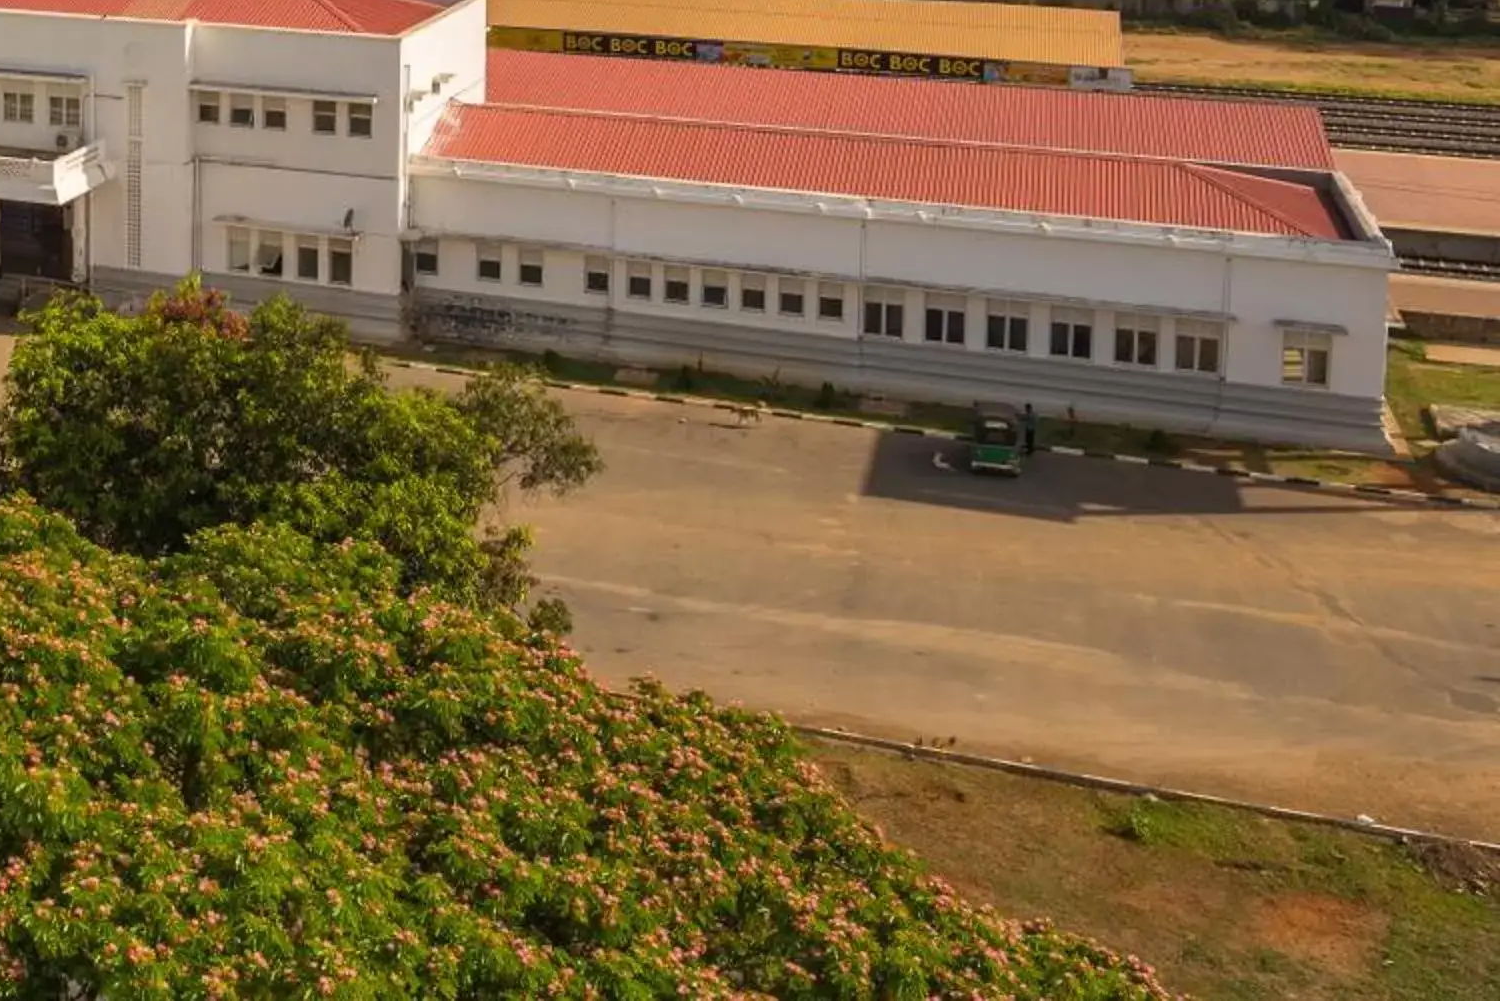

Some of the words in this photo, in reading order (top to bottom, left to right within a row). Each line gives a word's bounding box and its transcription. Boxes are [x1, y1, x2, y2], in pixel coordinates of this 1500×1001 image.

[566, 35, 604, 50] BOC
[610, 38, 647, 54] BOC
[655, 40, 693, 56] BOC
[840, 51, 881, 69] BOC
[889, 53, 930, 72] BOC
[938, 59, 980, 76] BOC
